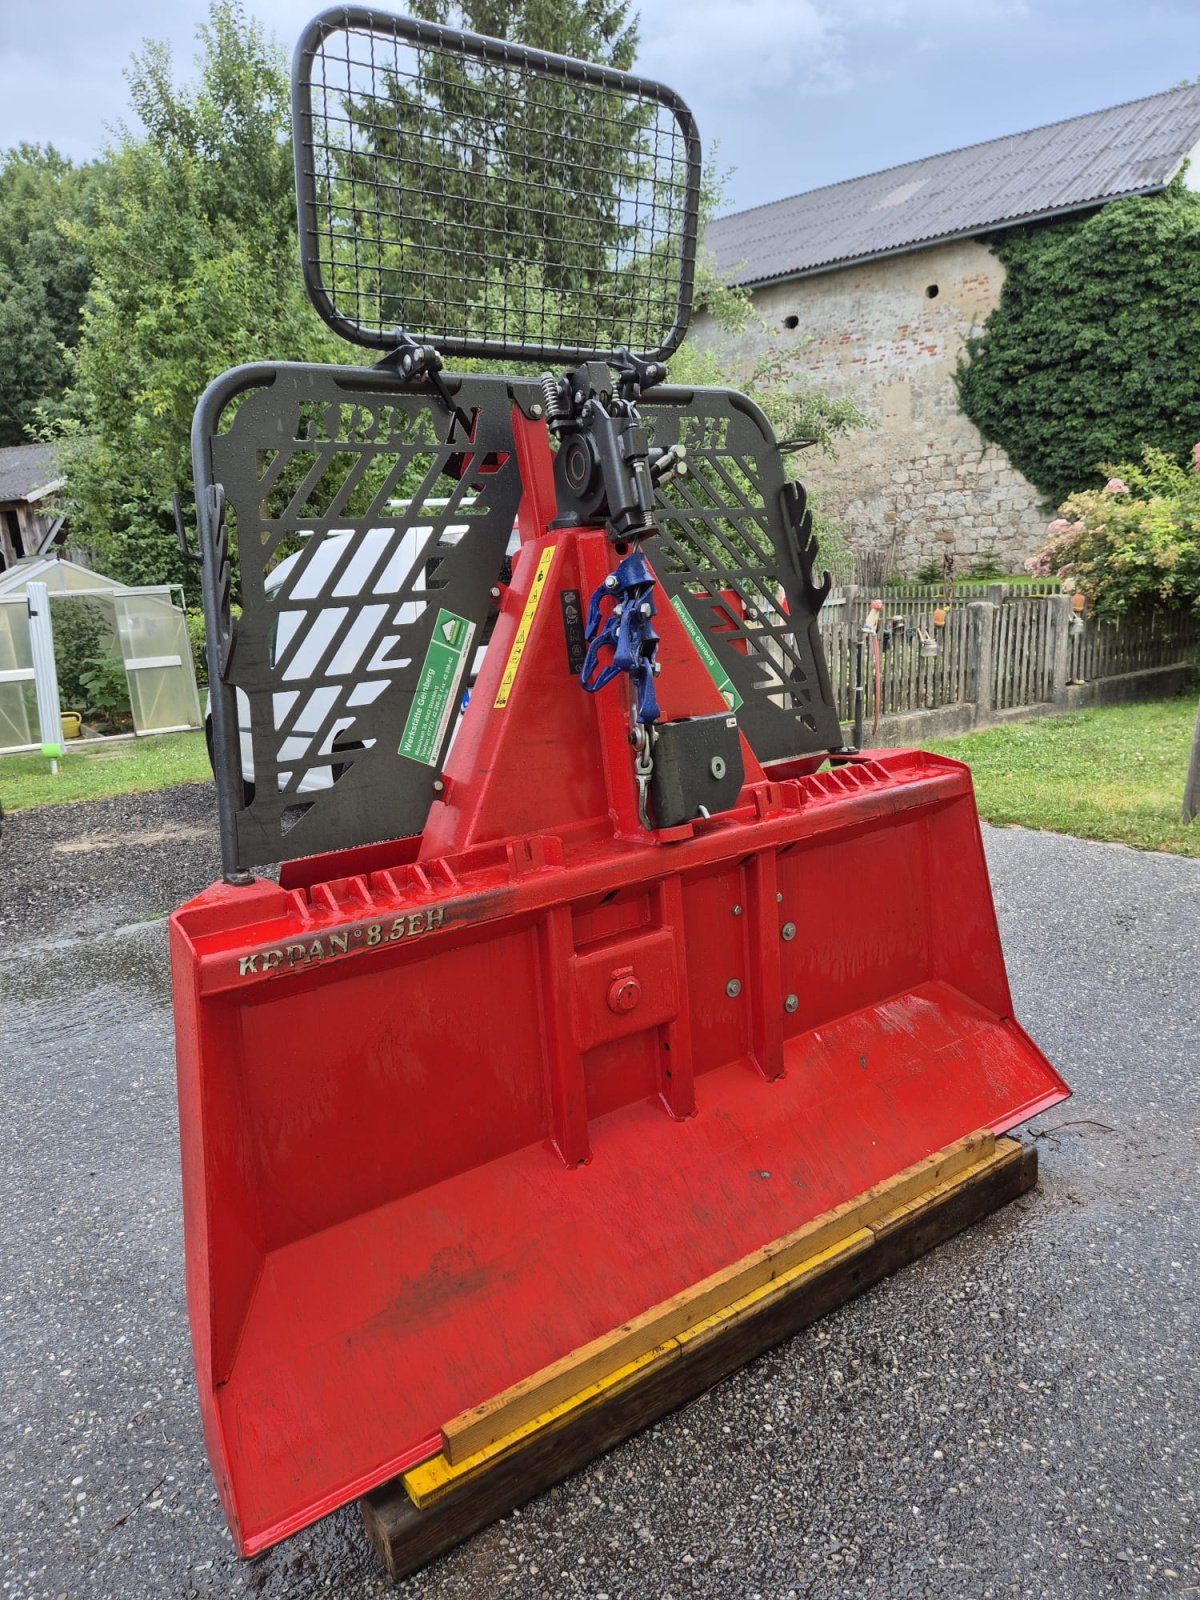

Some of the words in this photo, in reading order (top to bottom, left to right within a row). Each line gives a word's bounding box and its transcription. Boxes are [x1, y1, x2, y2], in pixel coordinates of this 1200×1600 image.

[293, 400, 482, 446] KRPAN
[403, 706, 422, 752] Werkstätte
[418, 668, 435, 705] Geinberg
